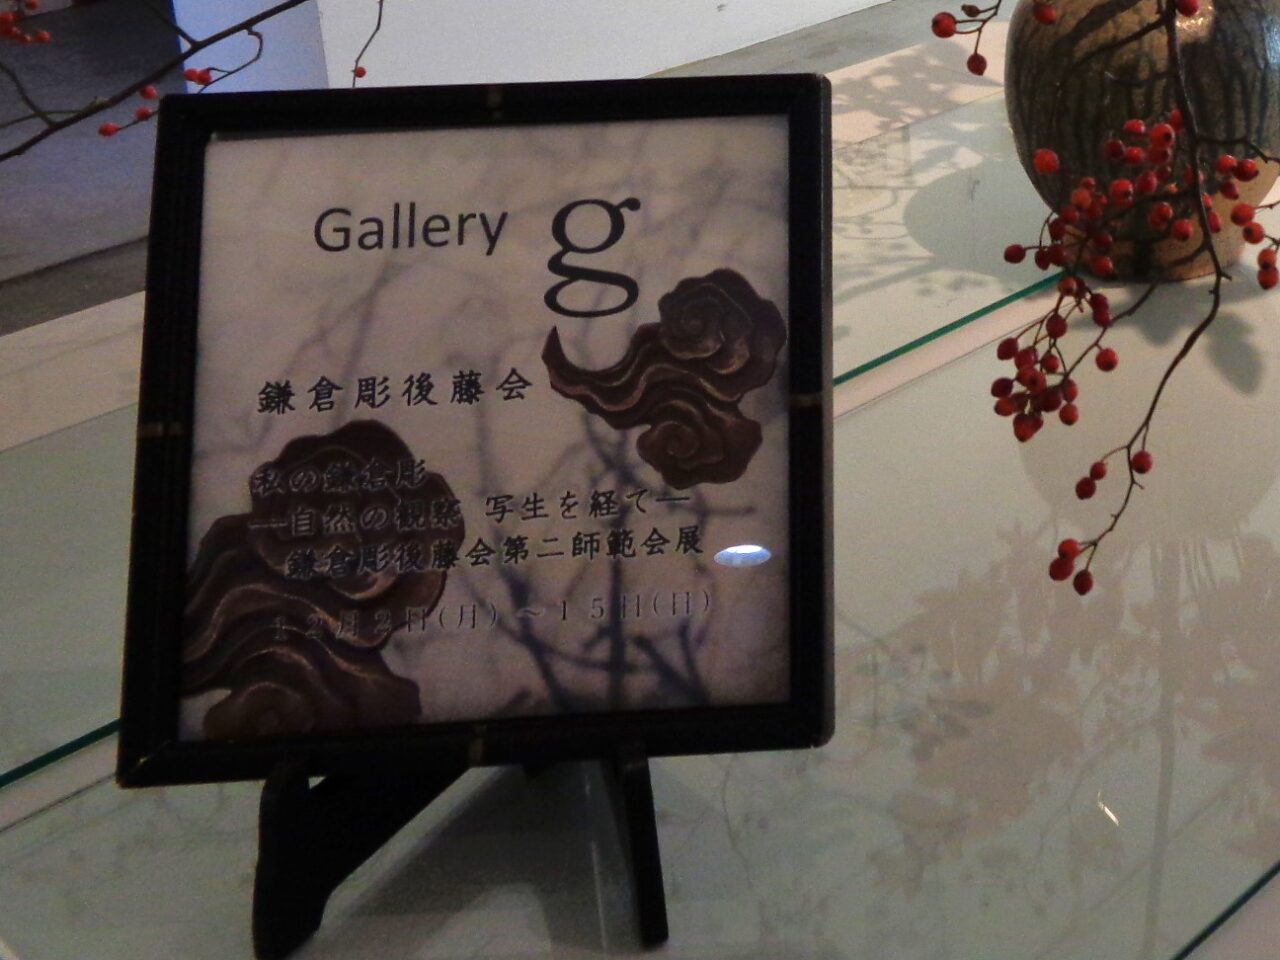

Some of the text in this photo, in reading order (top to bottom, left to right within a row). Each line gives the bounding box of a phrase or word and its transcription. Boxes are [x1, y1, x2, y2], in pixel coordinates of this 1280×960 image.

[314, 198, 641, 319] Gallery g
[258, 367, 534, 416] 鎌倉彫後藤会
[252, 457, 427, 497] 私の鎌倉彫
[285, 524, 705, 580] 鎌倉彫後藤会第二師範会展
